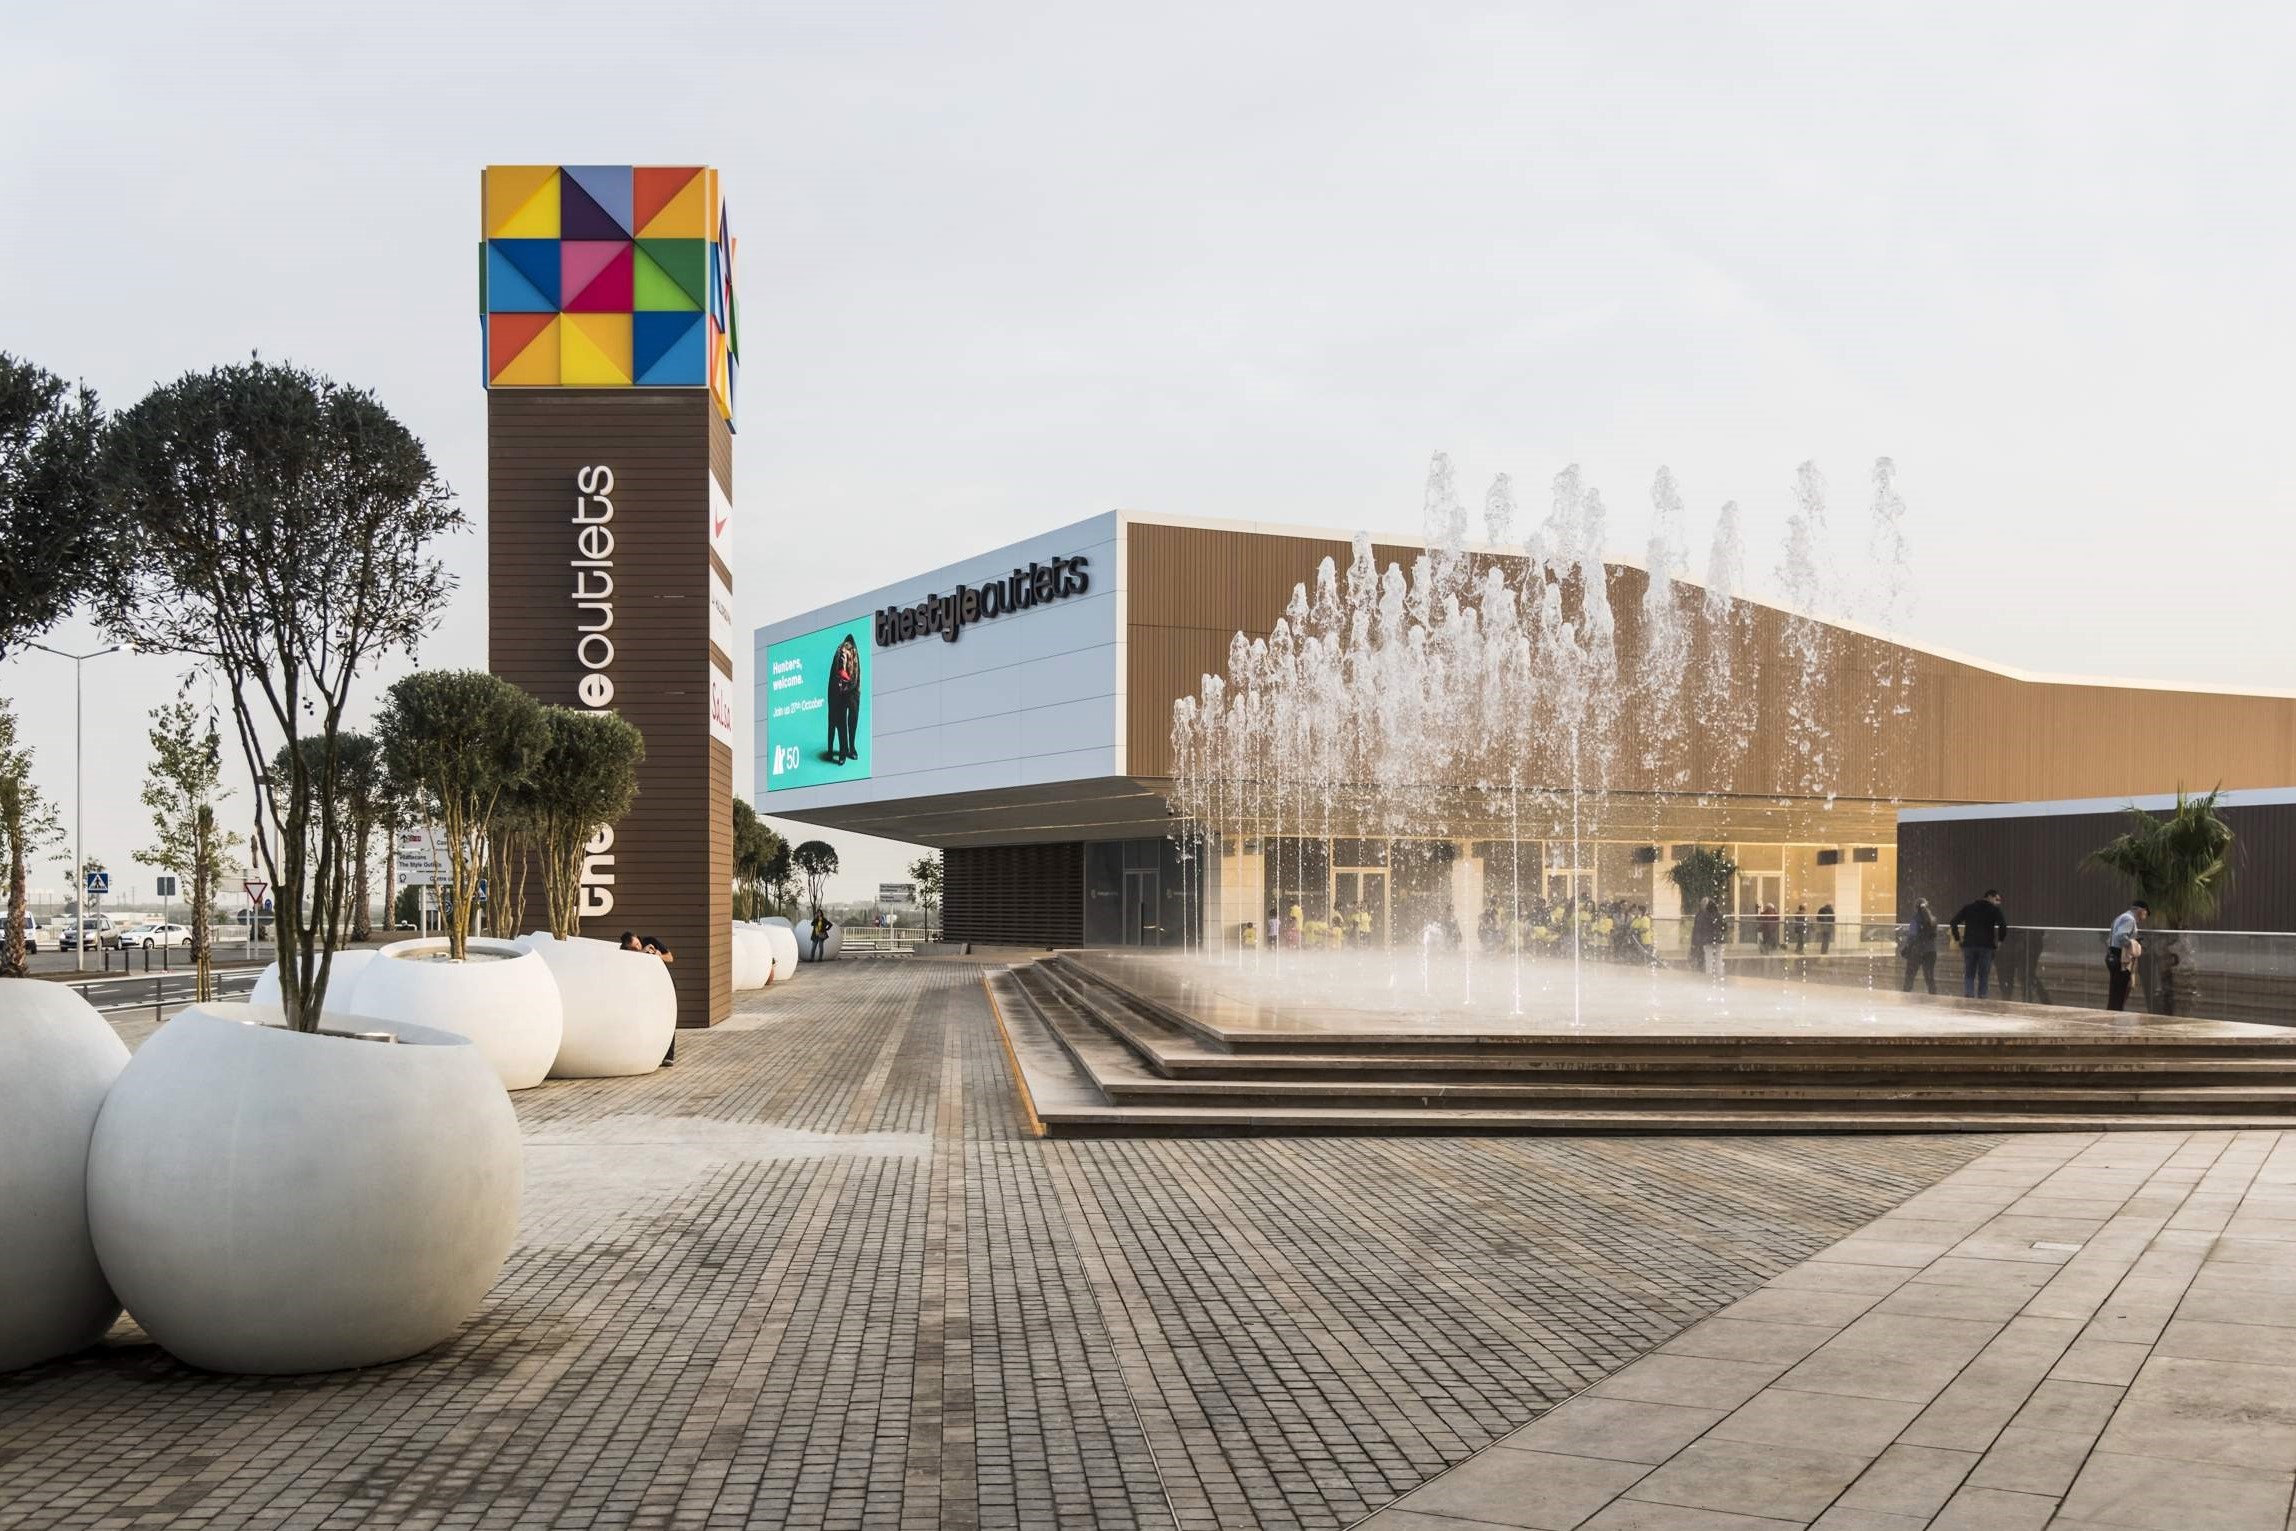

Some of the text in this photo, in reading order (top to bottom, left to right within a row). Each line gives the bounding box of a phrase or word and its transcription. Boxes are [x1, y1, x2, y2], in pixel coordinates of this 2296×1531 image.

[875, 556, 1089, 647] thestyleoutlets
[773, 658, 803, 675] Hunters,
[571, 465, 615, 917] theeoutlets
[773, 675, 803, 691] welcome.
[786, 746, 800, 770] 50
